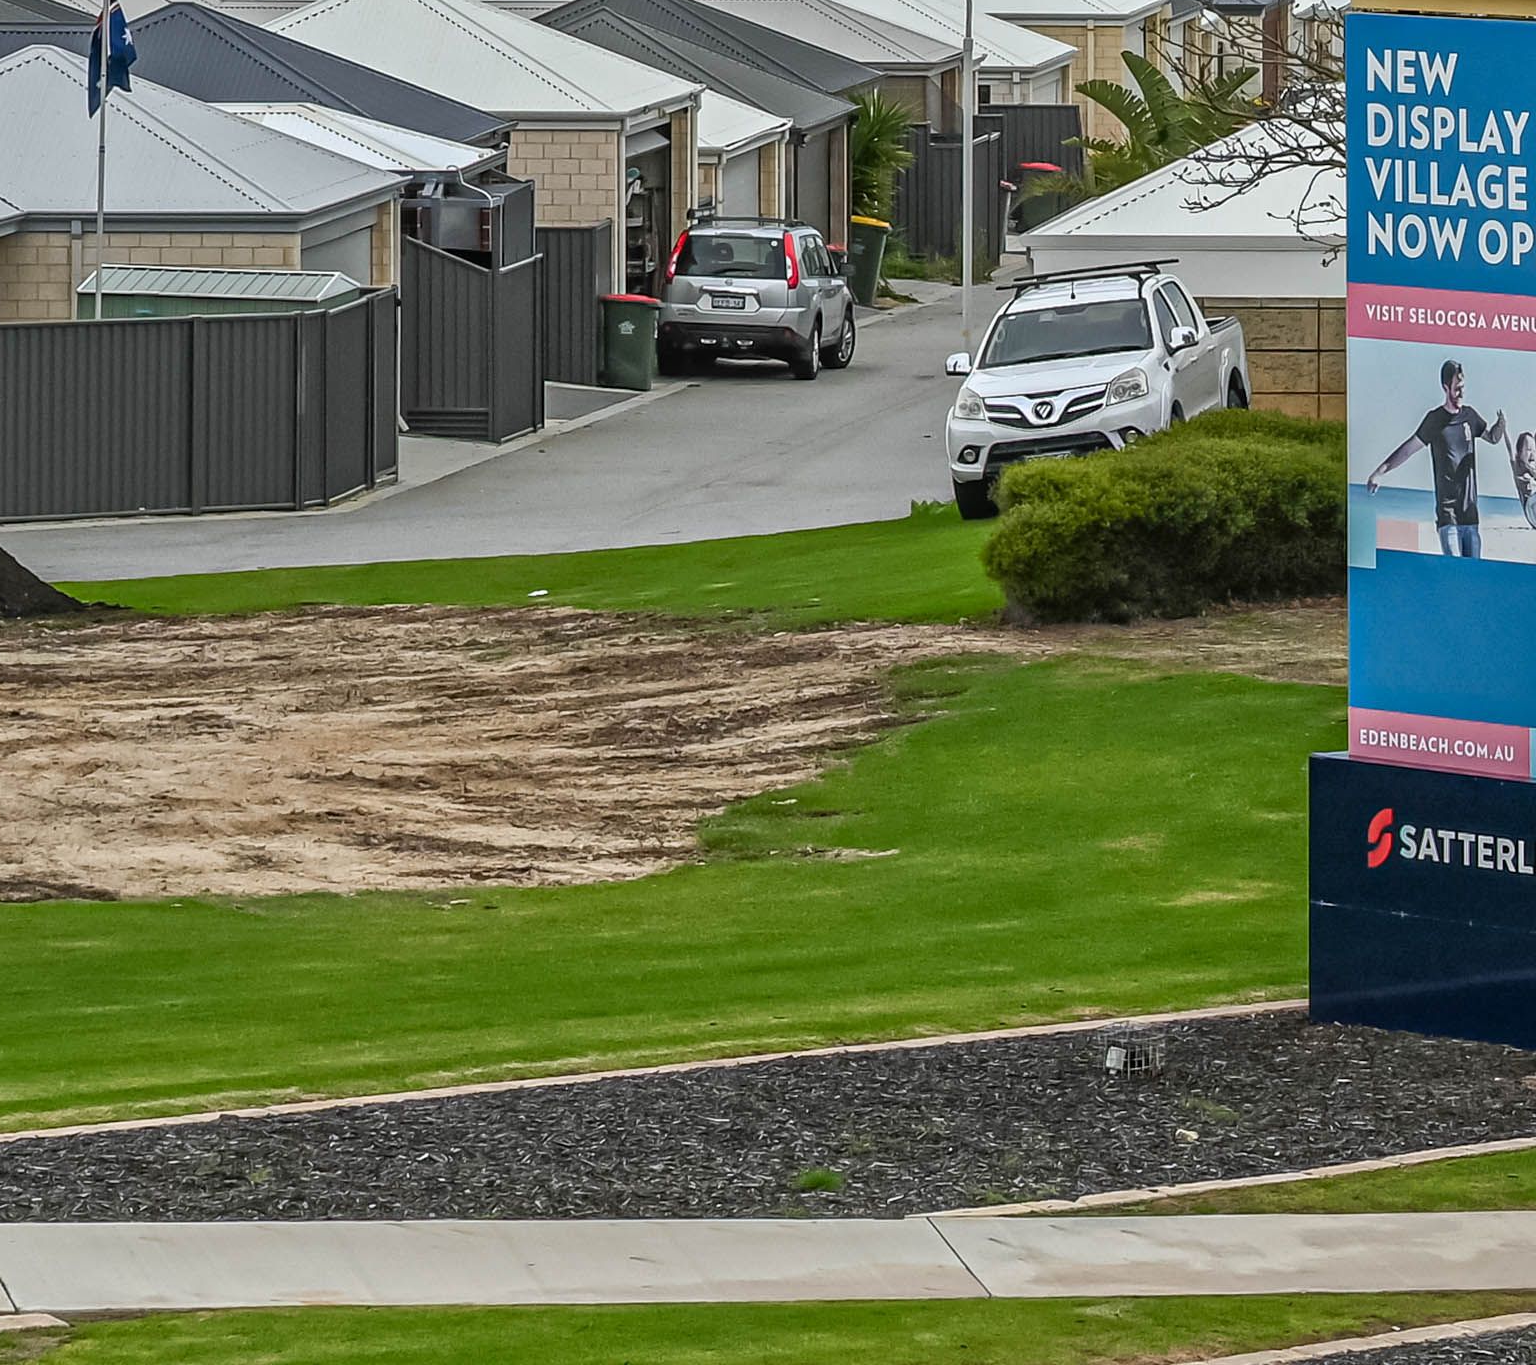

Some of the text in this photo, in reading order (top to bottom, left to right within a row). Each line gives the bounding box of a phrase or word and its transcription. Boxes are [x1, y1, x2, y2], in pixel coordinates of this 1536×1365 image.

[1366, 46, 1458, 96] NEW
[1366, 103, 1530, 155] DISPLAY
[1365, 157, 1528, 211] VILLAGE
[1366, 212, 1467, 261] NOW
[1365, 304, 1404, 323] VISIT
[1409, 307, 1487, 329] SELOCOSA
[1359, 728, 1515, 762] EDENBEACH.COM.AU
